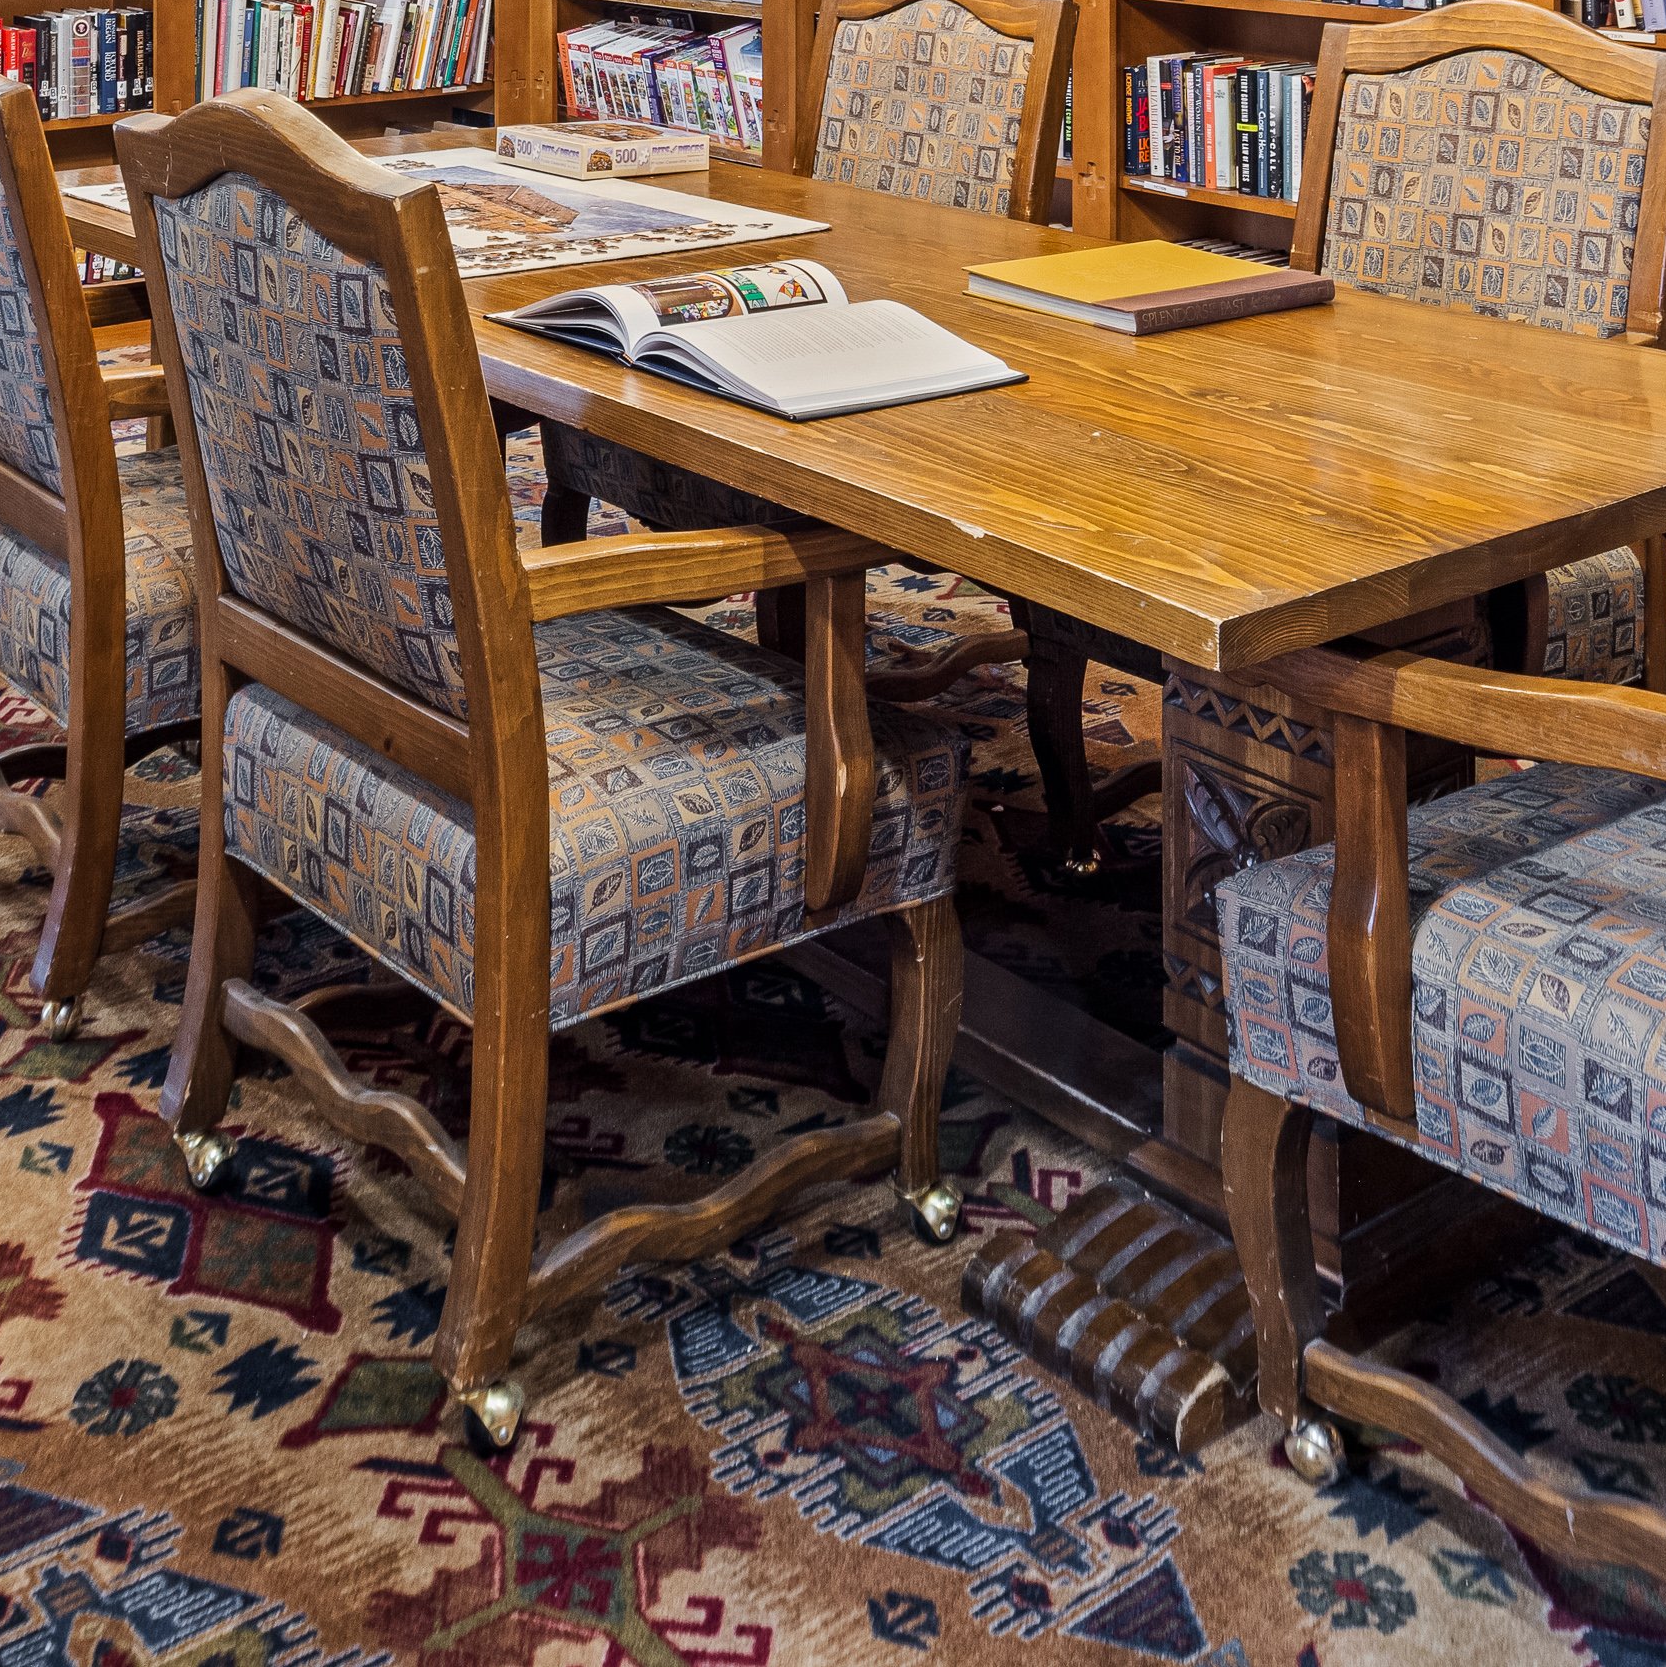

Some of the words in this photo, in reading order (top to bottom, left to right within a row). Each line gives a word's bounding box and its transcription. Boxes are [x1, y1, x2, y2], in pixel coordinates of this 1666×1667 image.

[517, 138, 532, 156] 500
[615, 148, 638, 164] 500
[1220, 298, 1246, 316] PAST
